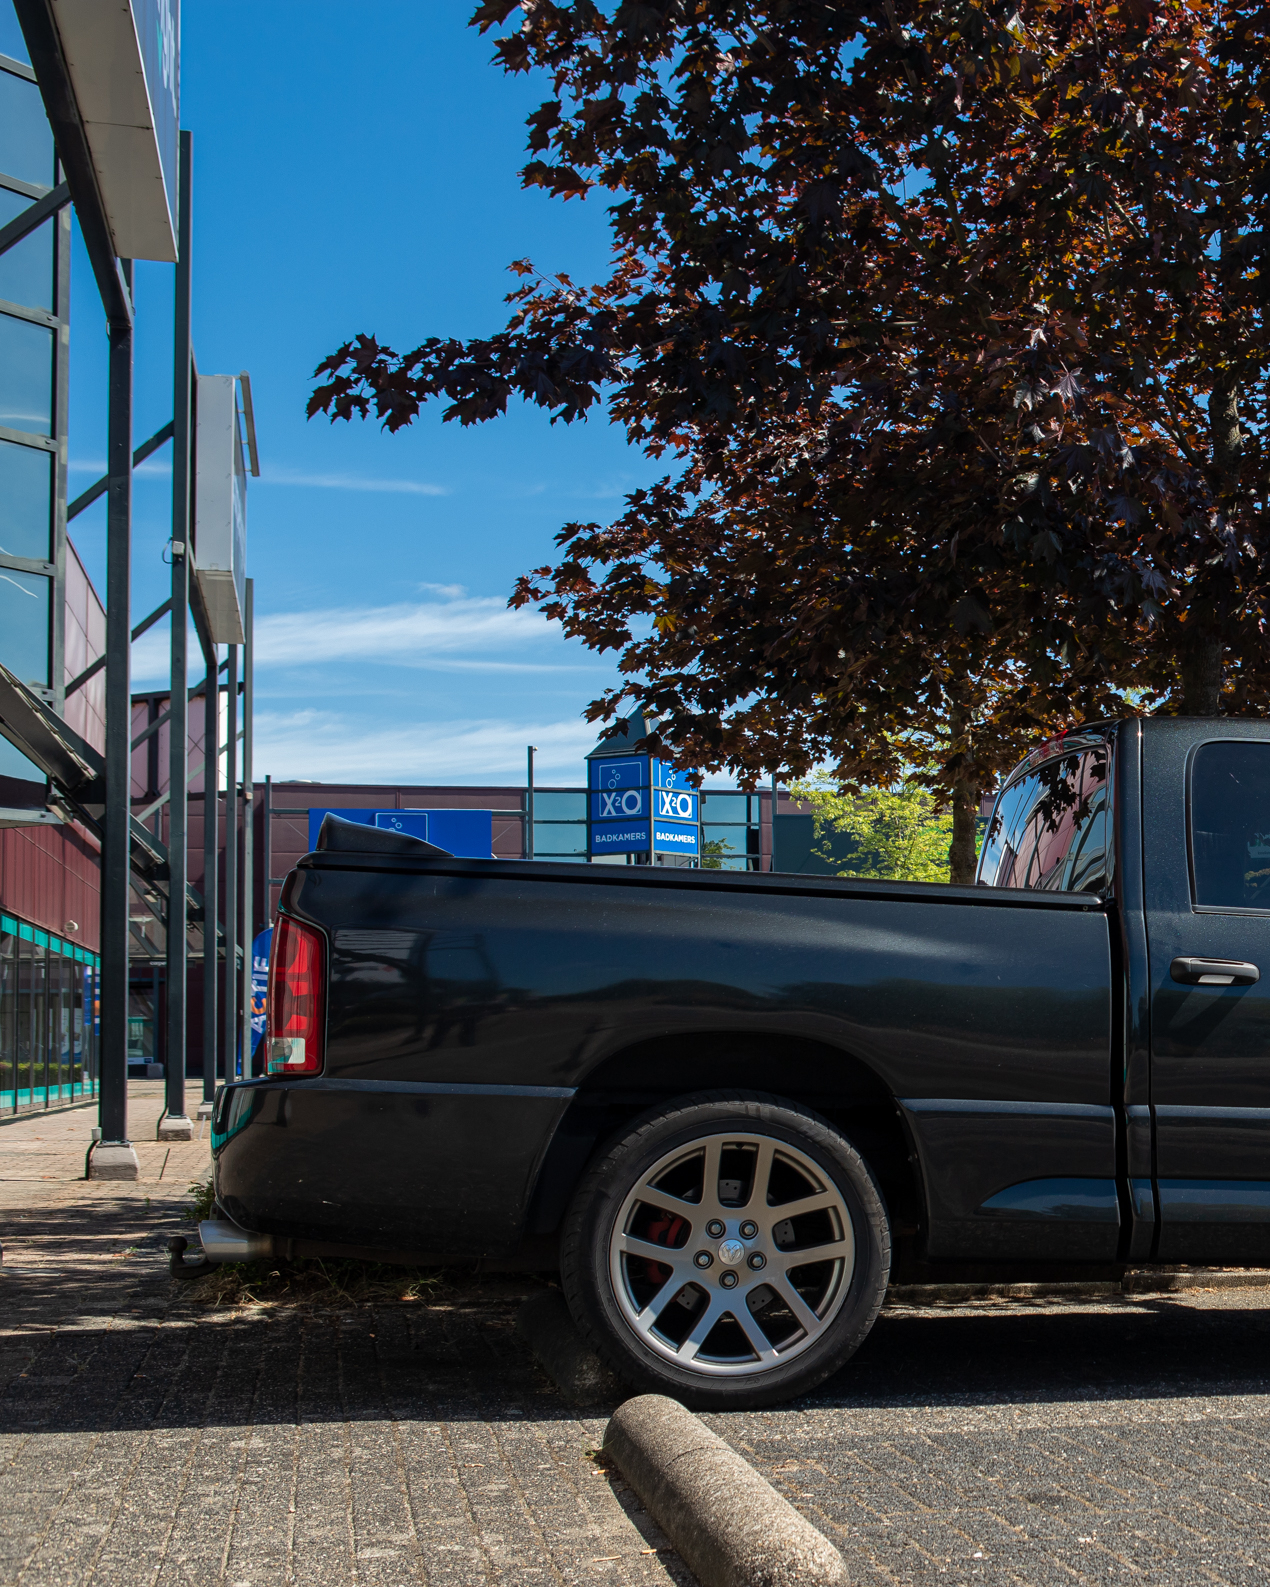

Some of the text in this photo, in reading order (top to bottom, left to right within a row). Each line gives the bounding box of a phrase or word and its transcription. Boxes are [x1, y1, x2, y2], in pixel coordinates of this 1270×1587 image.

[595, 832, 646, 843] BADKAMERS
[656, 832, 696, 844] BADKAMERS
[250, 956, 269, 1034] ACTIE
